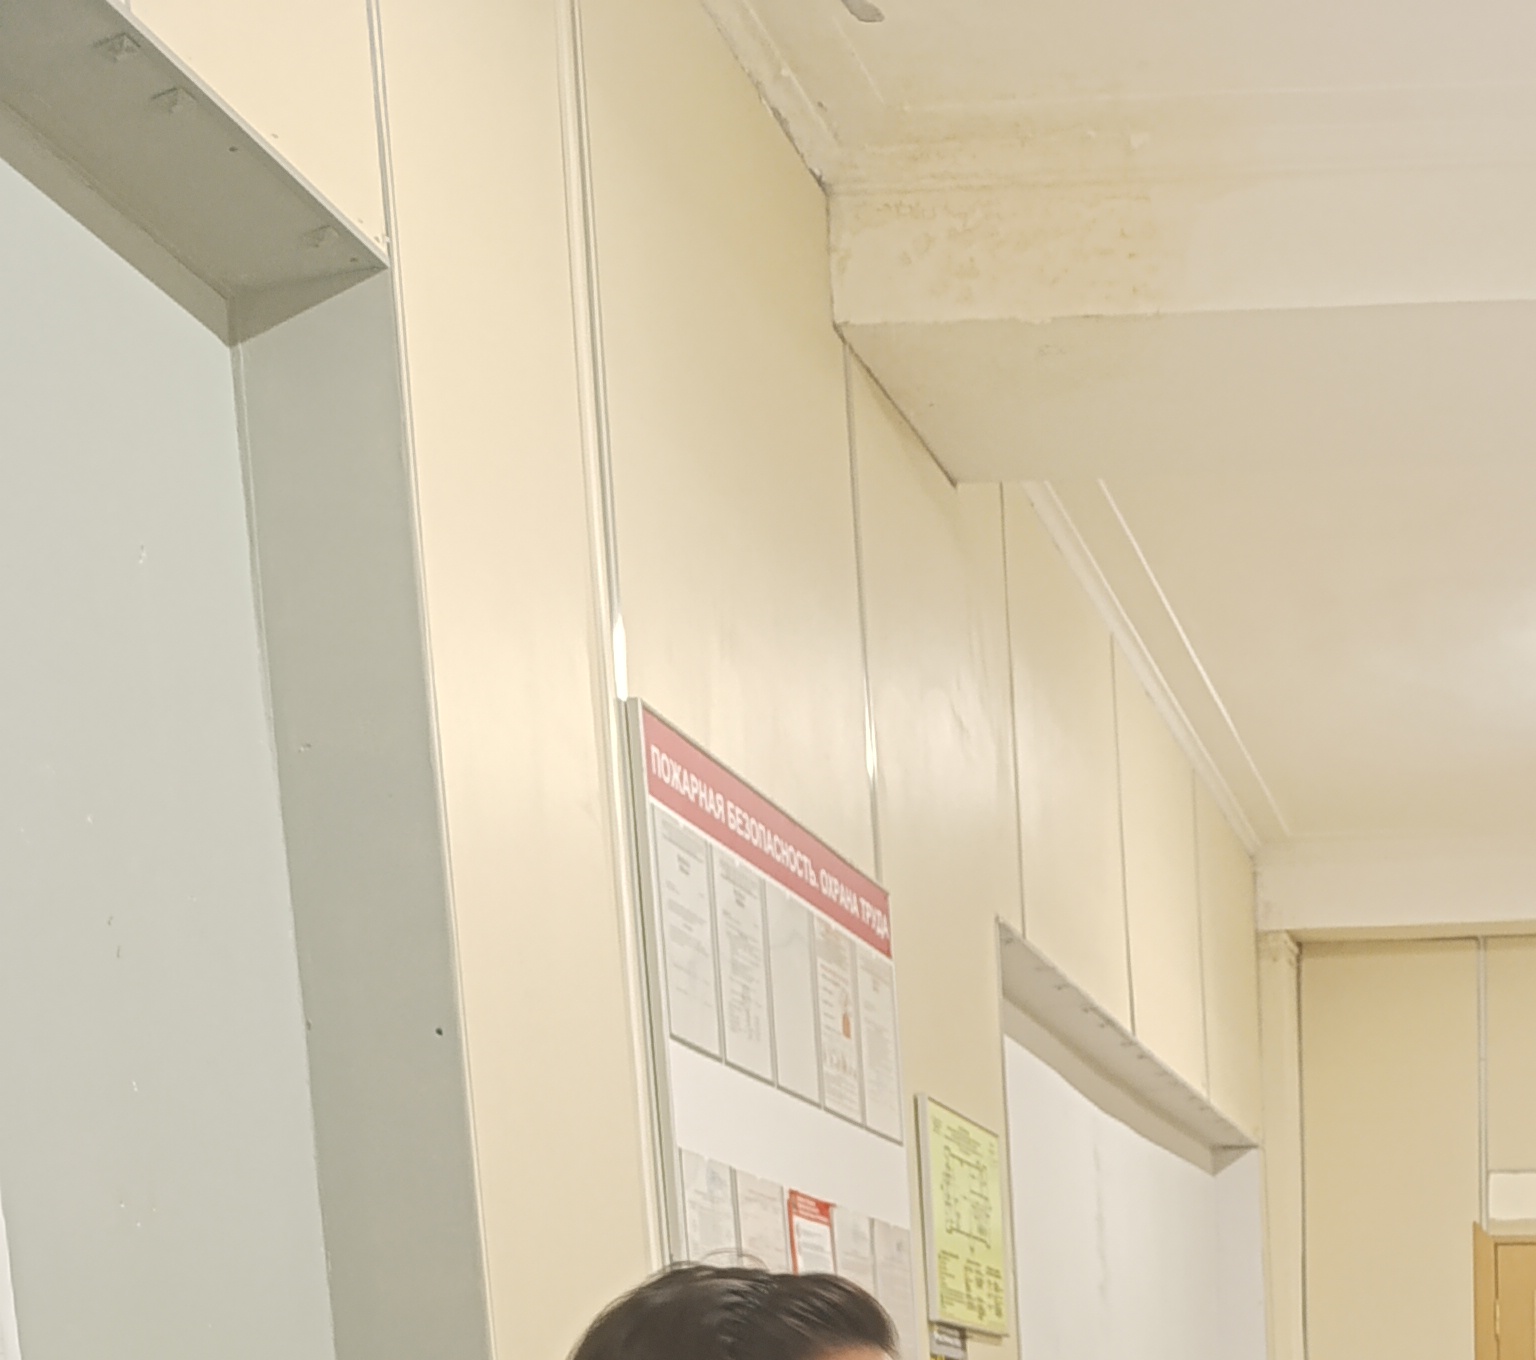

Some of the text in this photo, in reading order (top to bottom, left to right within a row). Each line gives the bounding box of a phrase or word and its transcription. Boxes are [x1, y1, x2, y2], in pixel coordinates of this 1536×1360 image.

[650, 744, 726, 824] ПОЖАРНАЯ
[819, 868, 861, 921] ОХРАНА
[860, 896, 890, 940] ТРУДА
